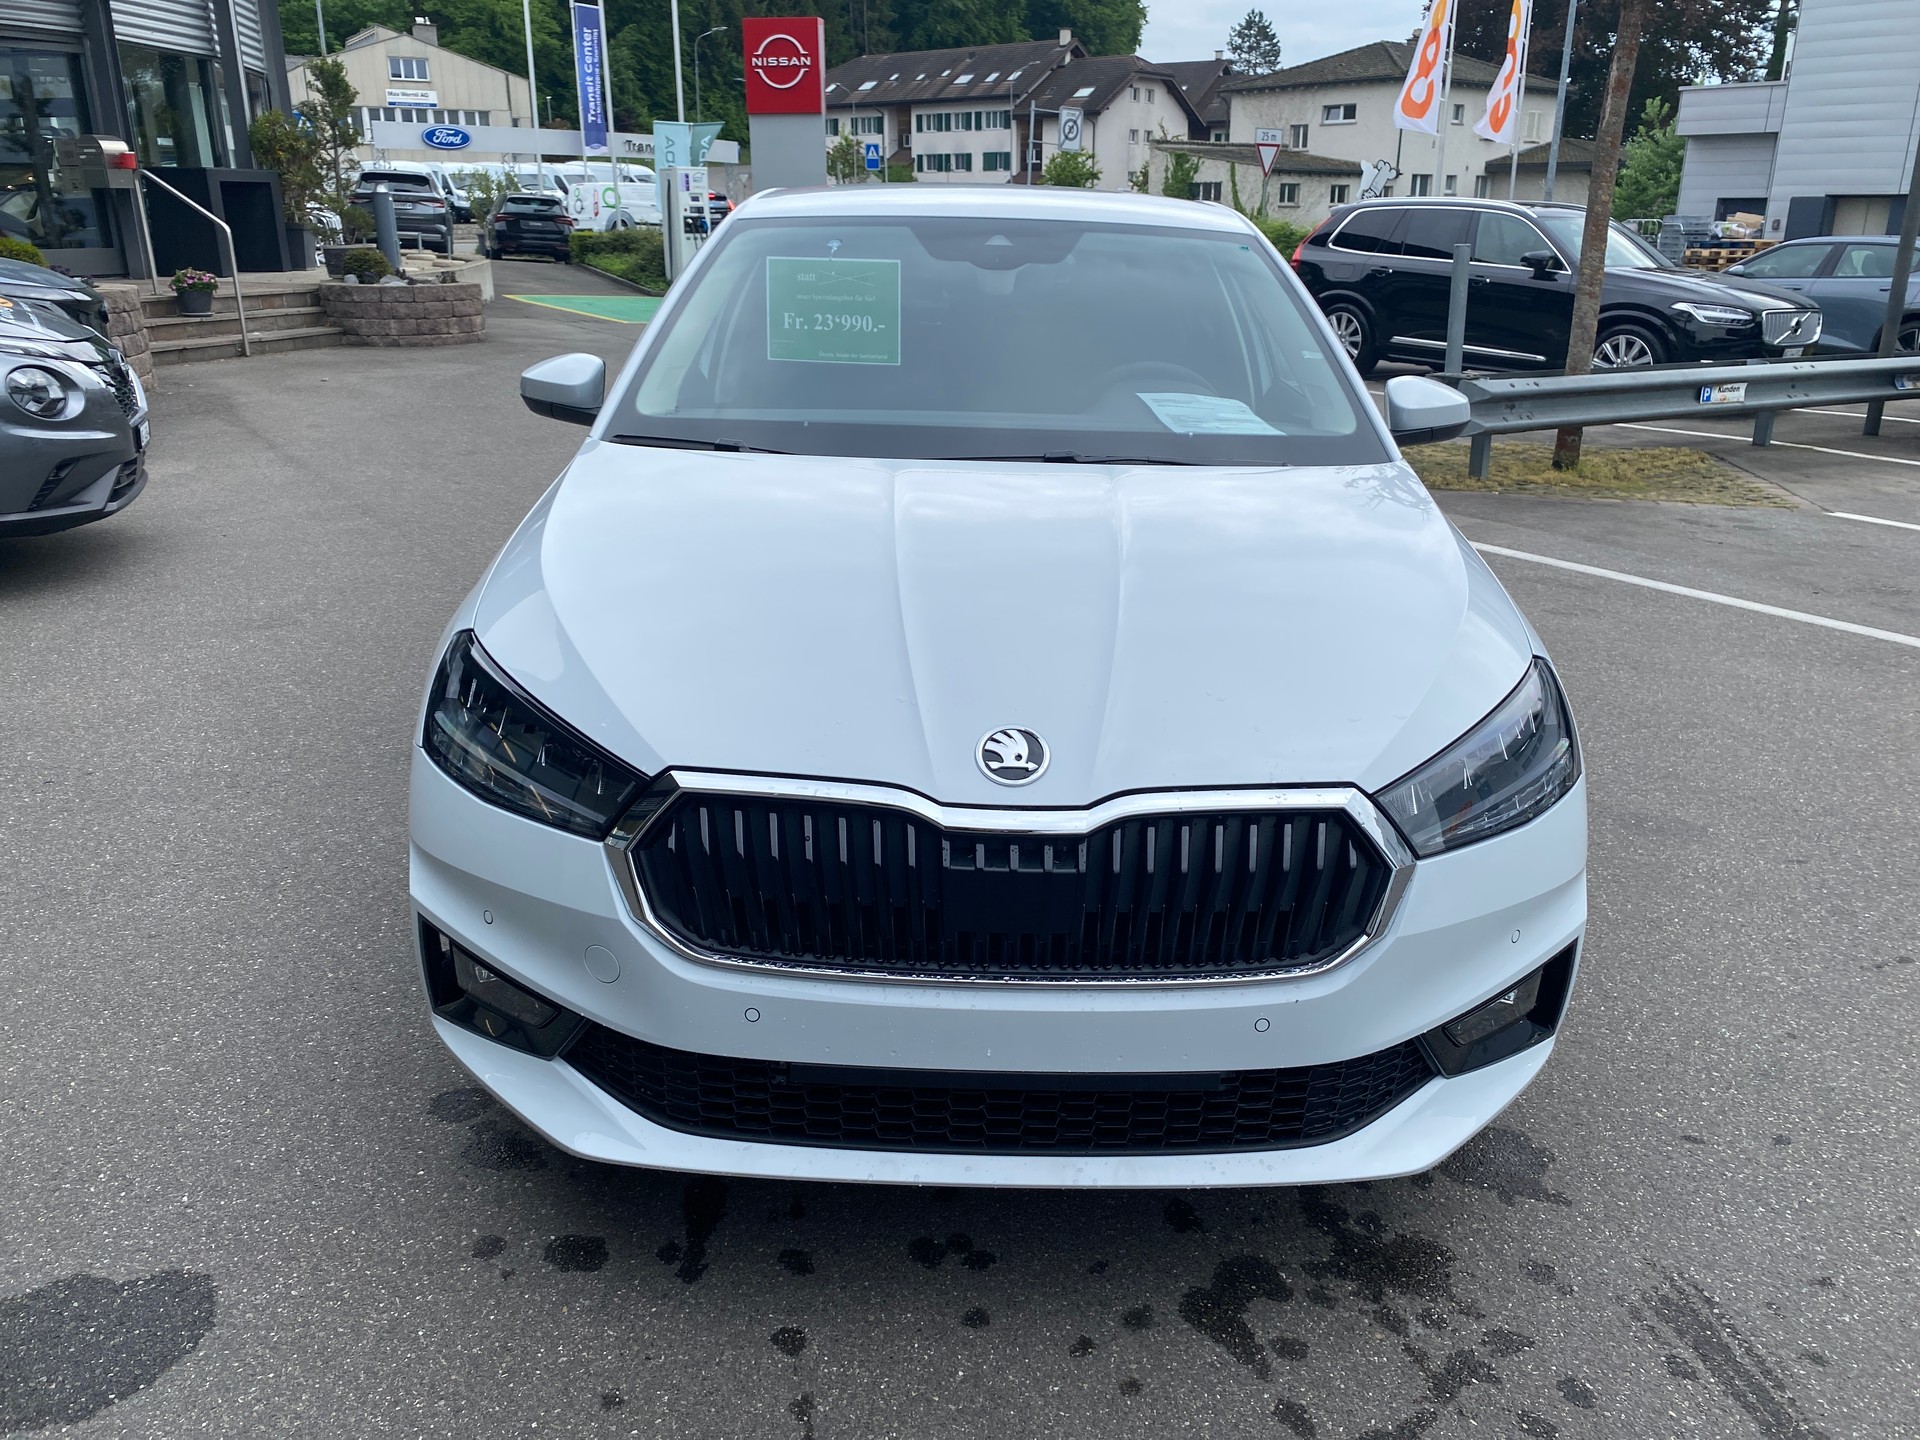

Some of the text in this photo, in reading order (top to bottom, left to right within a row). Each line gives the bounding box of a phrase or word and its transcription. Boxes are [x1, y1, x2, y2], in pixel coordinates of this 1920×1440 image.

[752, 57, 811, 66] NISSAN
[583, 27, 597, 123] Transit Center
[433, 129, 462, 144] Ford
[1261, 131, 1269, 141] 25
[624, 140, 655, 153] Tran
[797, 273, 816, 282] statt
[783, 312, 808, 330] Fr.
[1704, 385, 1741, 401] P Kunden
